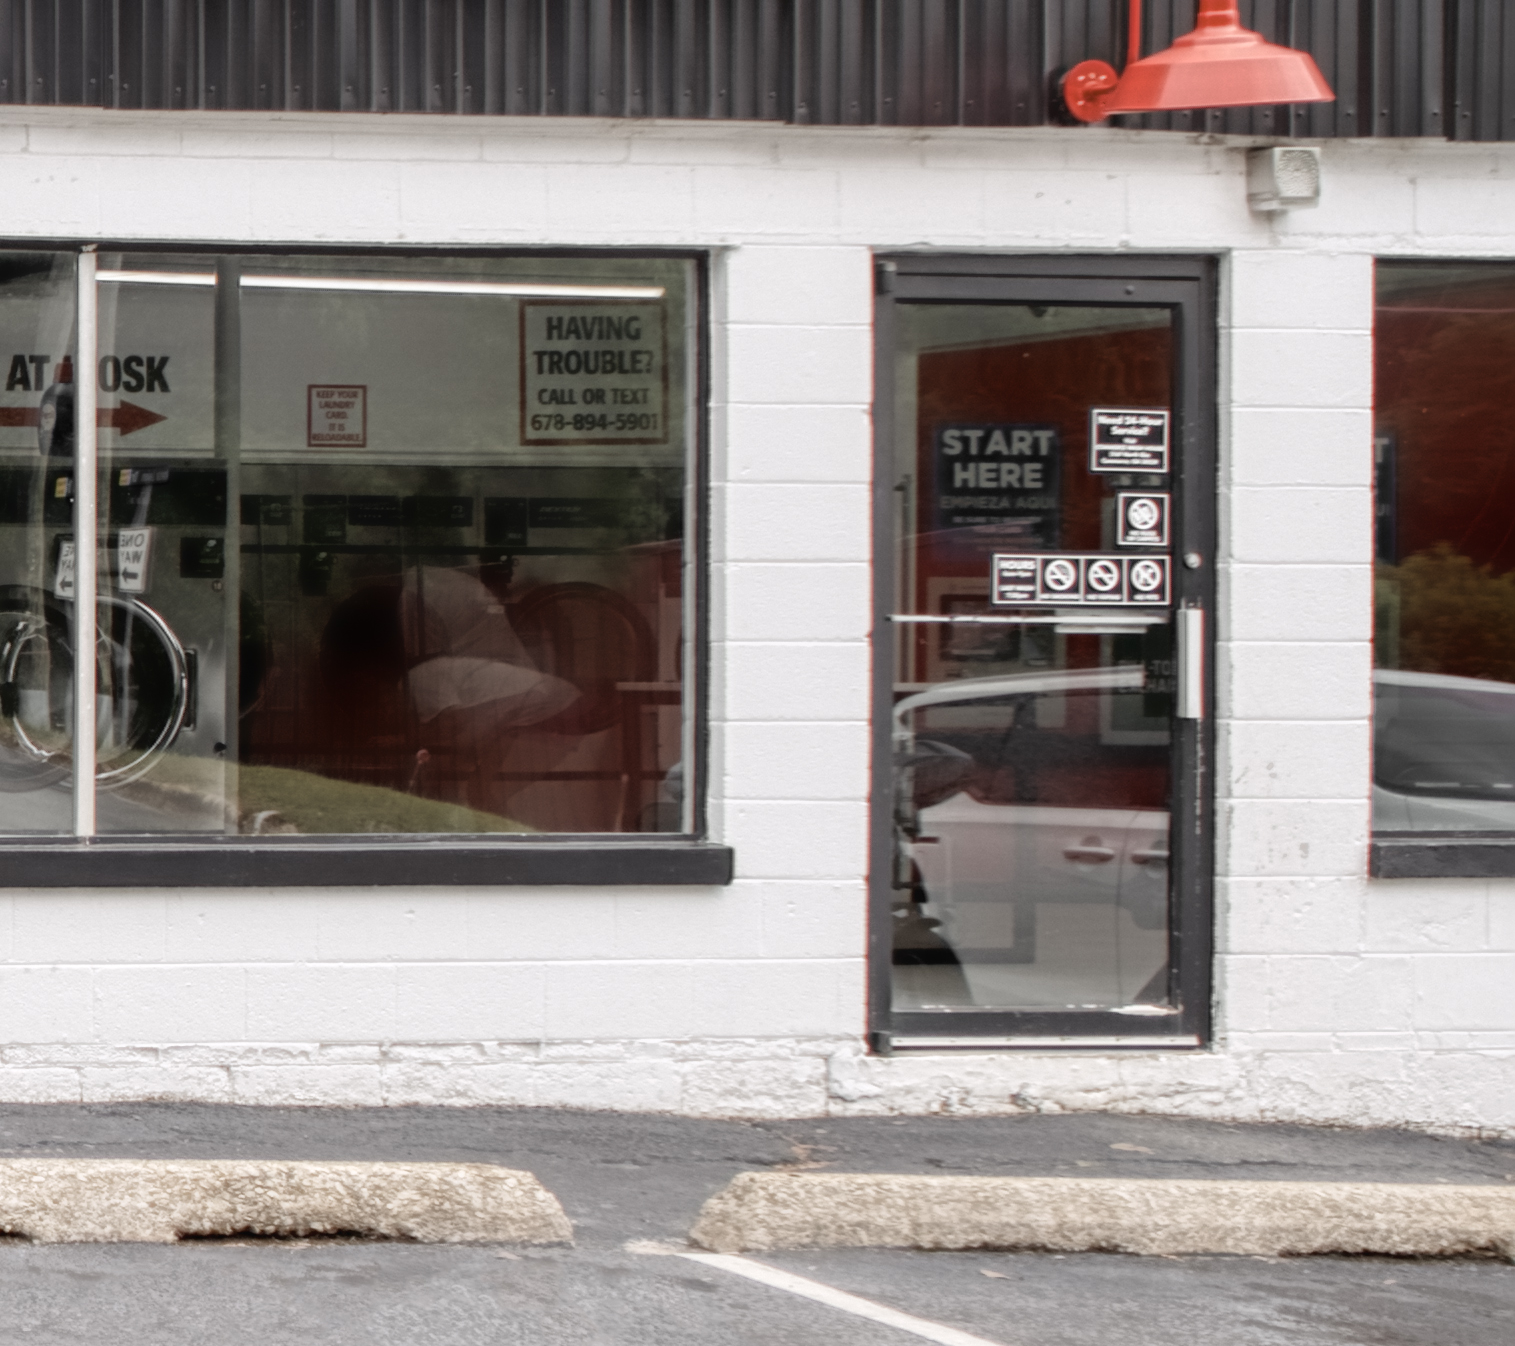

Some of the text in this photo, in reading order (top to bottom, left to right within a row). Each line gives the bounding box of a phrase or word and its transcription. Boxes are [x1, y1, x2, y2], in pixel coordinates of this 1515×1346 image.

[546, 316, 642, 341] HAVING
[533, 349, 654, 375] TROUBLE?
[5, 354, 51, 392] AT
[316, 390, 358, 398] KEEP YOUR
[538, 388, 650, 405] CALL OR TEXT
[319, 401, 355, 409] LAUNDRY
[530, 413, 658, 431] 678-894-5901
[942, 429, 1056, 456] START
[953, 462, 1044, 488] HERE
[940, 495, 1011, 509] EMPIEZA
